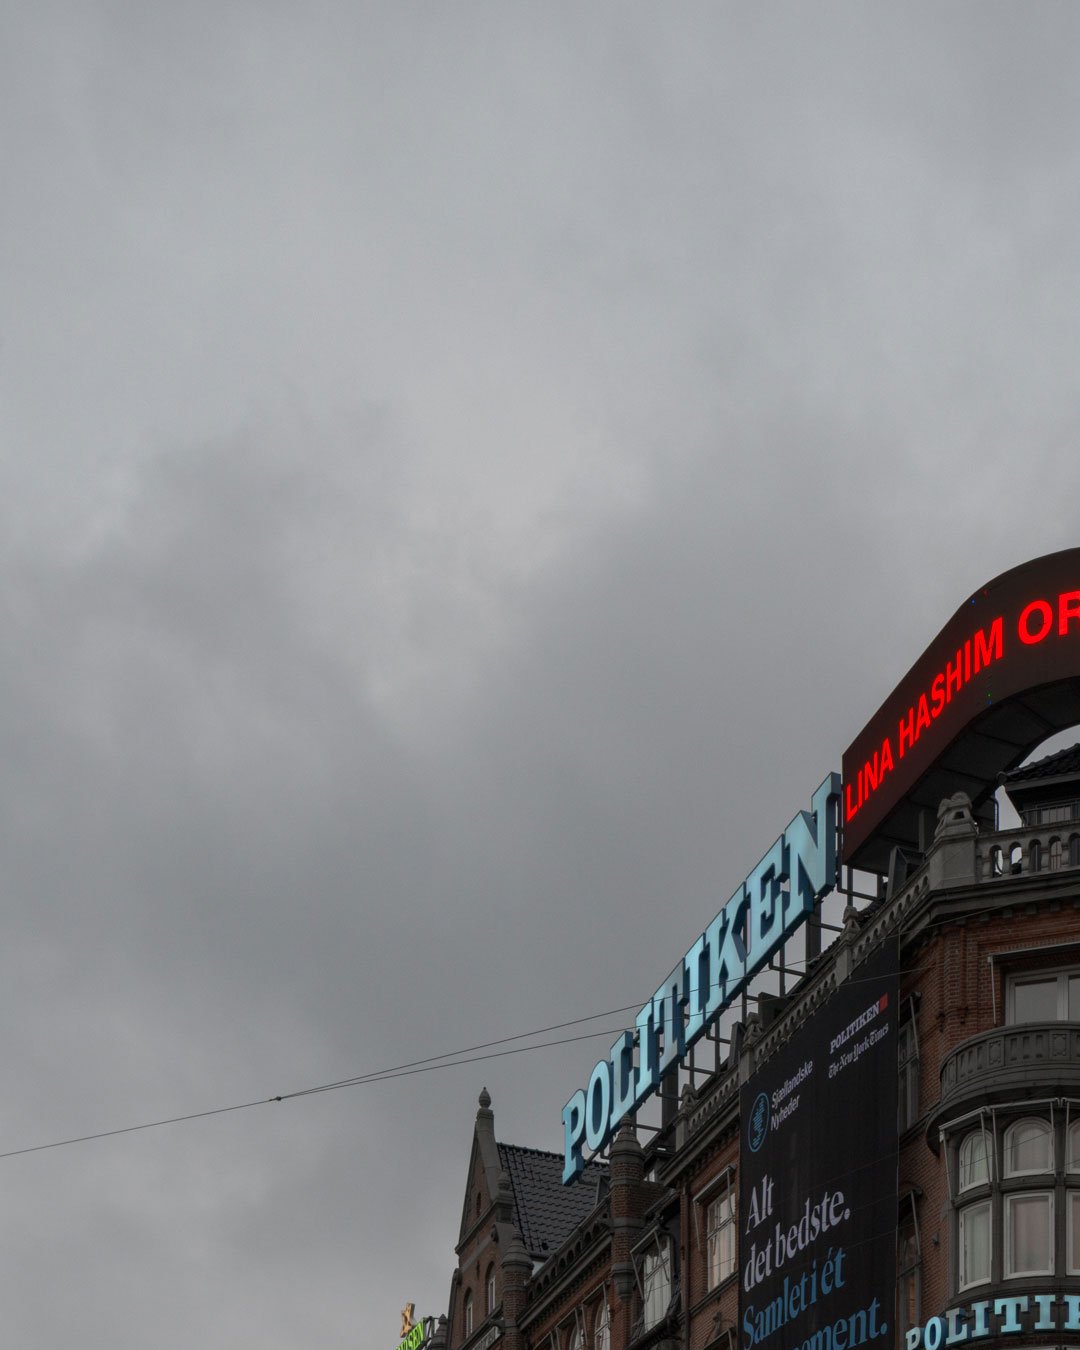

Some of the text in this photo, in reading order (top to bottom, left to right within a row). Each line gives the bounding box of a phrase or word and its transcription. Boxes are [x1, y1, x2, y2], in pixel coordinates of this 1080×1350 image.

[846, 738, 894, 822] LINA
[899, 616, 1003, 759] HASHIM
[562, 771, 842, 1186] POLITIKEN
[829, 1000, 880, 1054] POLITIKEN
[770, 1094, 800, 1132] Nyheder
[771, 1059, 814, 1109] Sjællandske
[745, 1173, 775, 1235] Alt
[744, 1189, 851, 1293] det bedste.
[809, 1258, 818, 1306] i
[820, 1246, 847, 1295] ét
